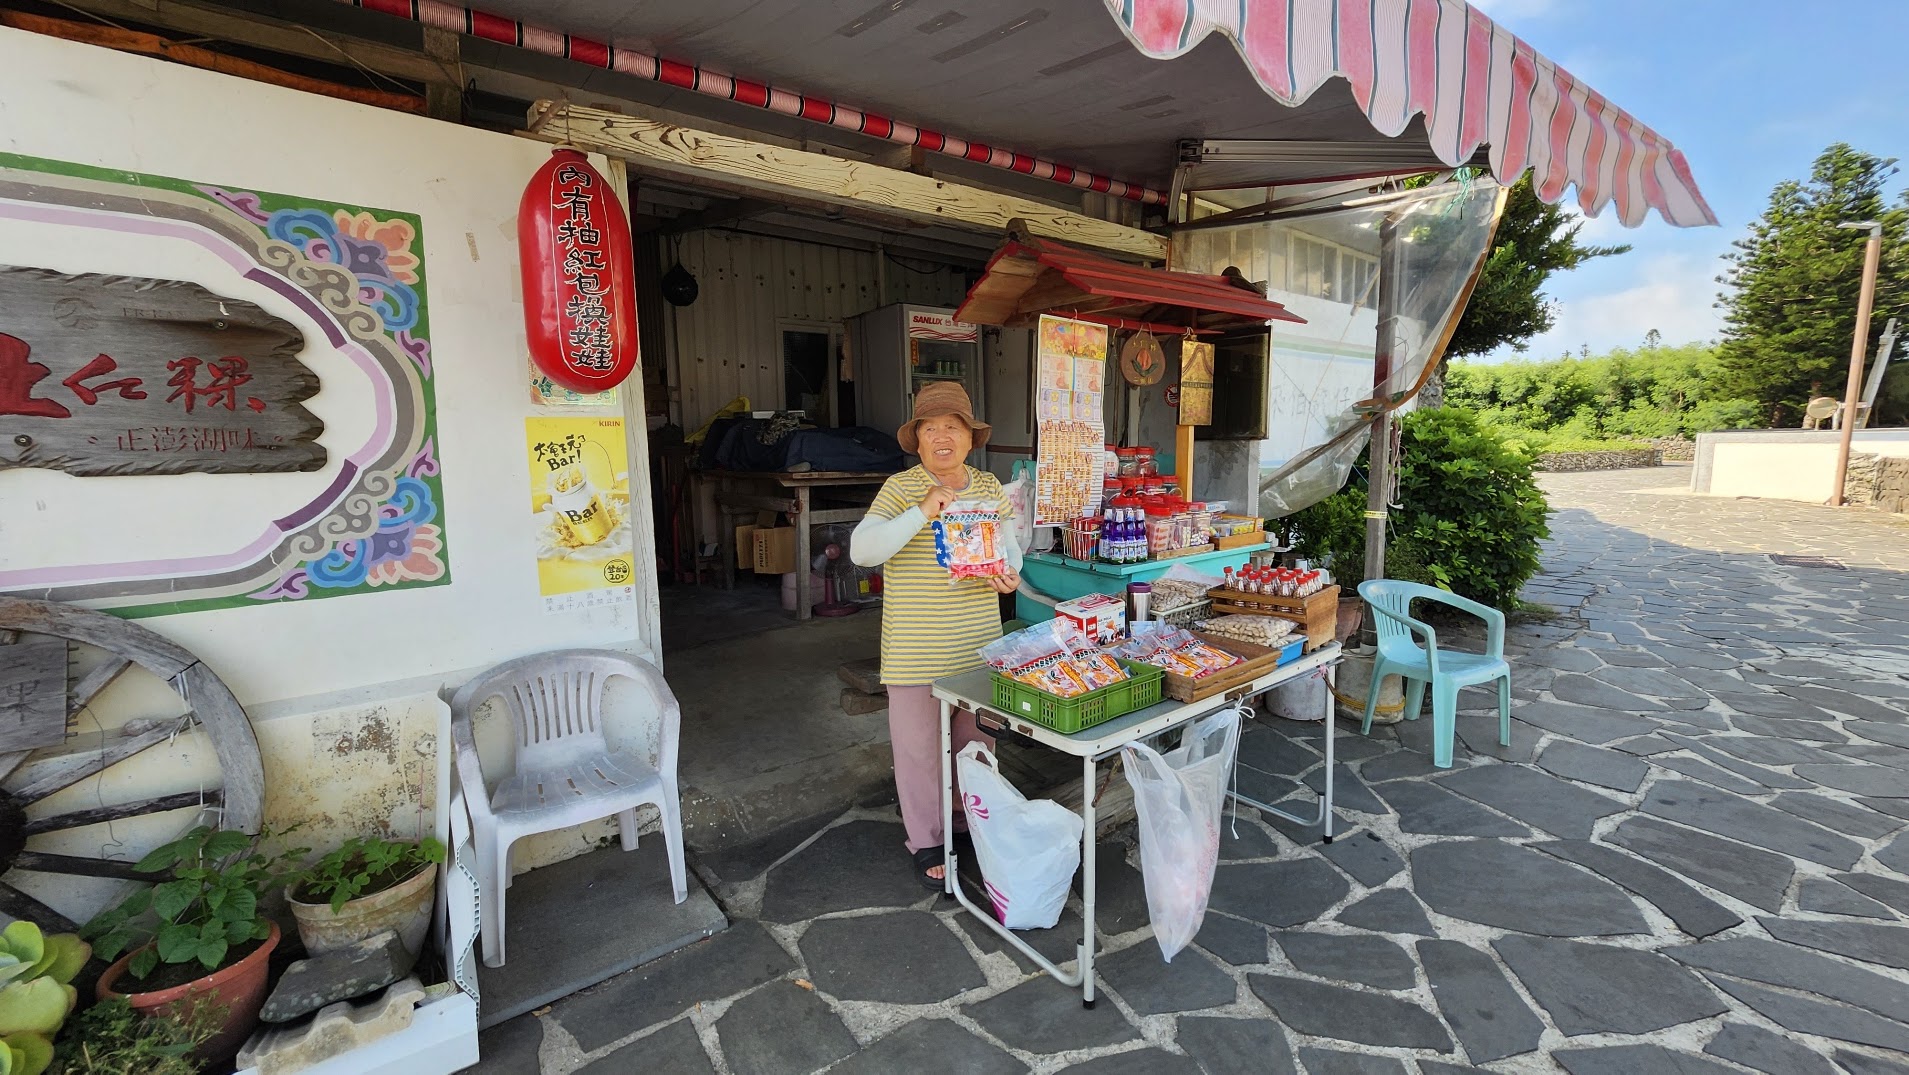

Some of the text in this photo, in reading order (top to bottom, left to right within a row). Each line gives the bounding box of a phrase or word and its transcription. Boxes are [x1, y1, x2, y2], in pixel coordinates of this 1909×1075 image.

[553, 166, 613, 370] 內有抽紅包換娃娃
[912, 315, 943, 325] SANLUX
[546, 449, 582, 471] Bar!
[564, 501, 598, 522] Bar
